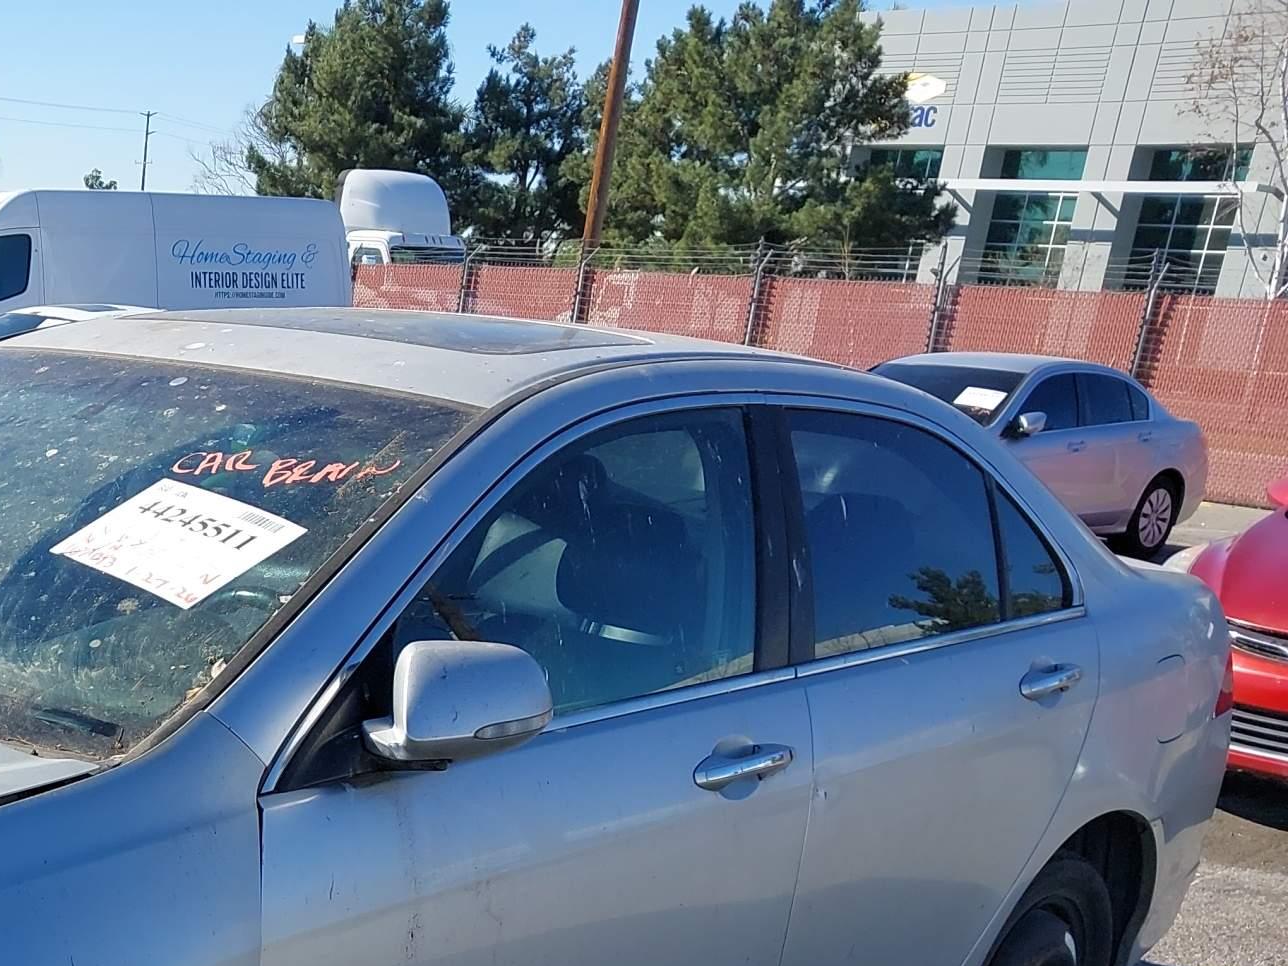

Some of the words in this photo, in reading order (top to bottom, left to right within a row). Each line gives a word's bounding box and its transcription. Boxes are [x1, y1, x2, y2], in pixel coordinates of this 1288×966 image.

[910, 105, 938, 128] ac
[301, 243, 319, 268] &
[191, 271, 239, 289] INTERIOR
[241, 271, 278, 289] DESIGN
[281, 272, 306, 289] ELITE
[171, 450, 261, 476] CAR
[137, 500, 259, 552] 44245511
